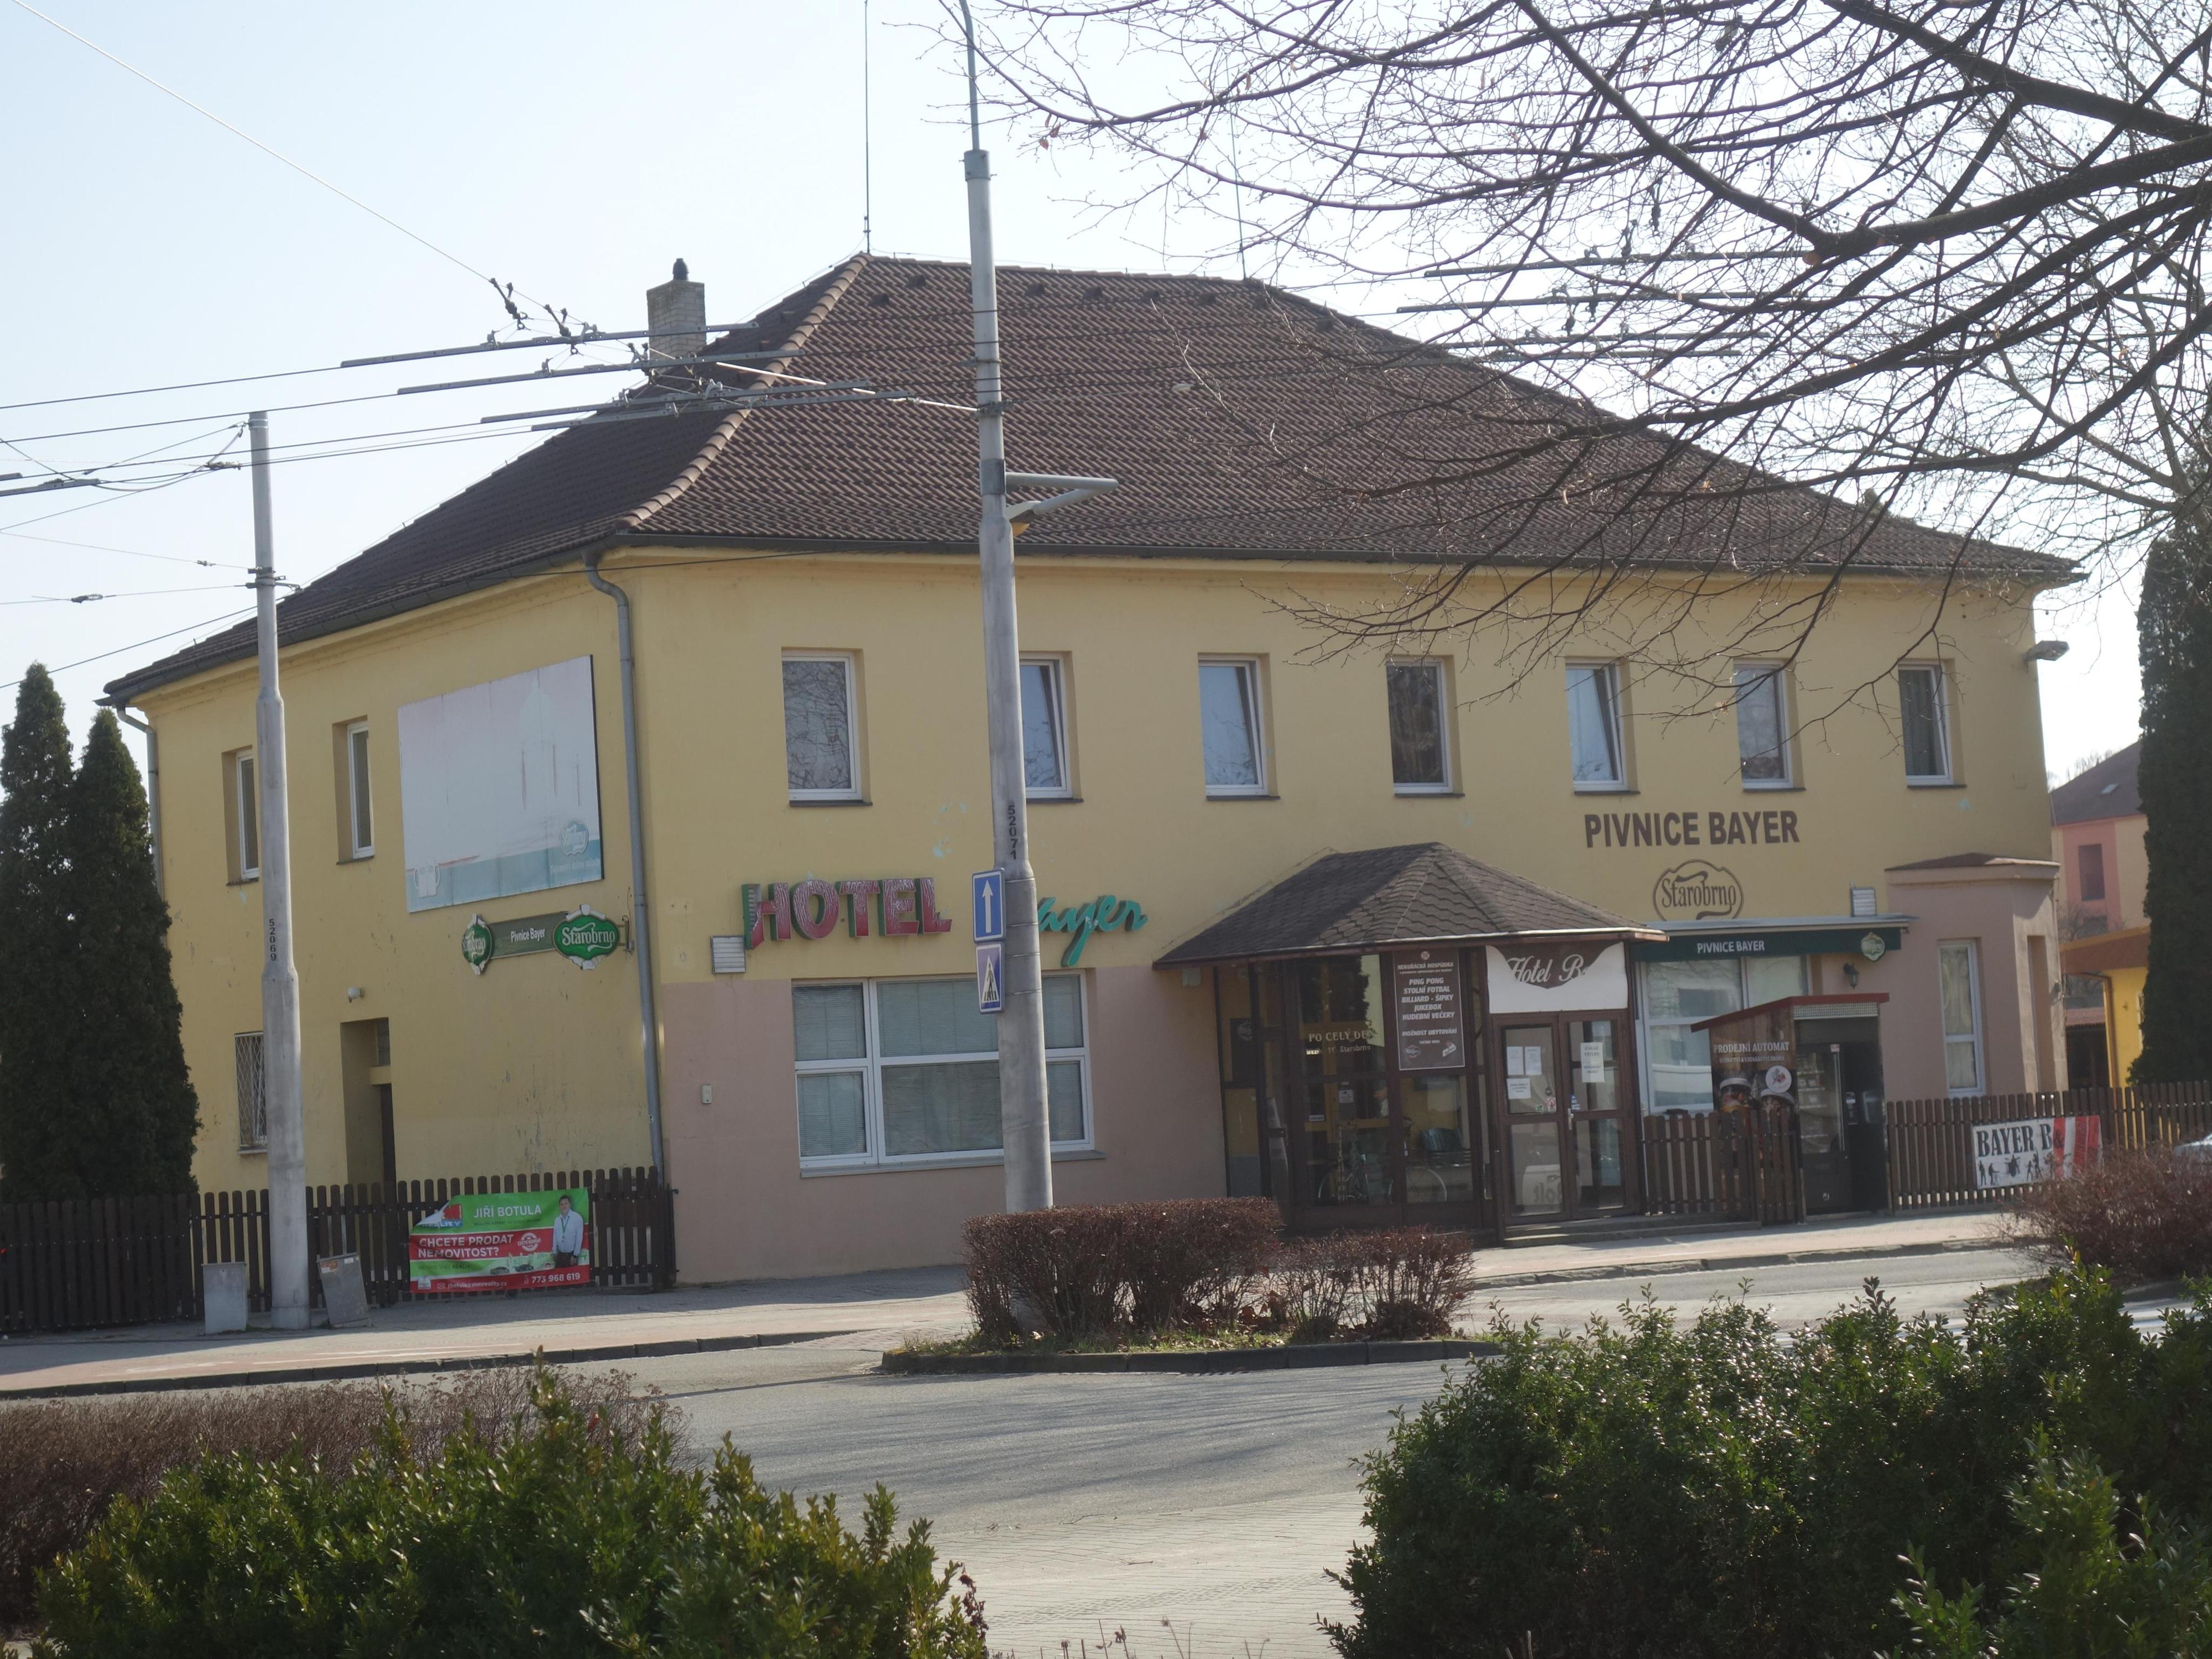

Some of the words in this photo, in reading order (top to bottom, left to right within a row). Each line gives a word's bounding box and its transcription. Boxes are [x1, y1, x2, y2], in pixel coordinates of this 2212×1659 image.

[1008, 805, 1018, 860] 52071
[1584, 812, 1700, 848] PIVNICE
[1709, 811, 1800, 844] BAYER
[1661, 870, 1737, 920] Starobrno
[742, 877, 952, 950] HOTEL
[1037, 895, 1148, 967] ayer
[510, 930, 529, 942] Pivnice
[530, 928, 545, 941] Bayer
[562, 922, 615, 952] Starobrno
[1697, 941, 1735, 954] PIVNICE
[1736, 940, 1765, 952] BAYER
[1507, 955, 1553, 983] Hotel
[1404, 985, 1426, 994] STOLNÍ
[1435, 993, 1454, 1001] ŠIPKY
[1415, 1003, 1442, 1012] JUKEBOX
[1402, 1011, 1431, 1020] HUDEBNÍ
[1431, 1010, 1455, 1019] VEČERY
[1309, 1032, 1322, 1042] PO
[1326, 1028, 1350, 1041] CELÝ
[1713, 1041, 1751, 1053] PRODEJNÍ
[1752, 1042, 1790, 1052] AUTOMAT
[1976, 1125, 2036, 1157] BAYER
[473, 1205, 494, 1218] JIŘÍ
[498, 1204, 542, 1217] BOTULA
[419, 1237, 465, 1247] CHCETE
[469, 1234, 514, 1246] PRODAT
[418, 1247, 499, 1258] NEMOVITOST?
[567, 1272, 580, 1281] 619
